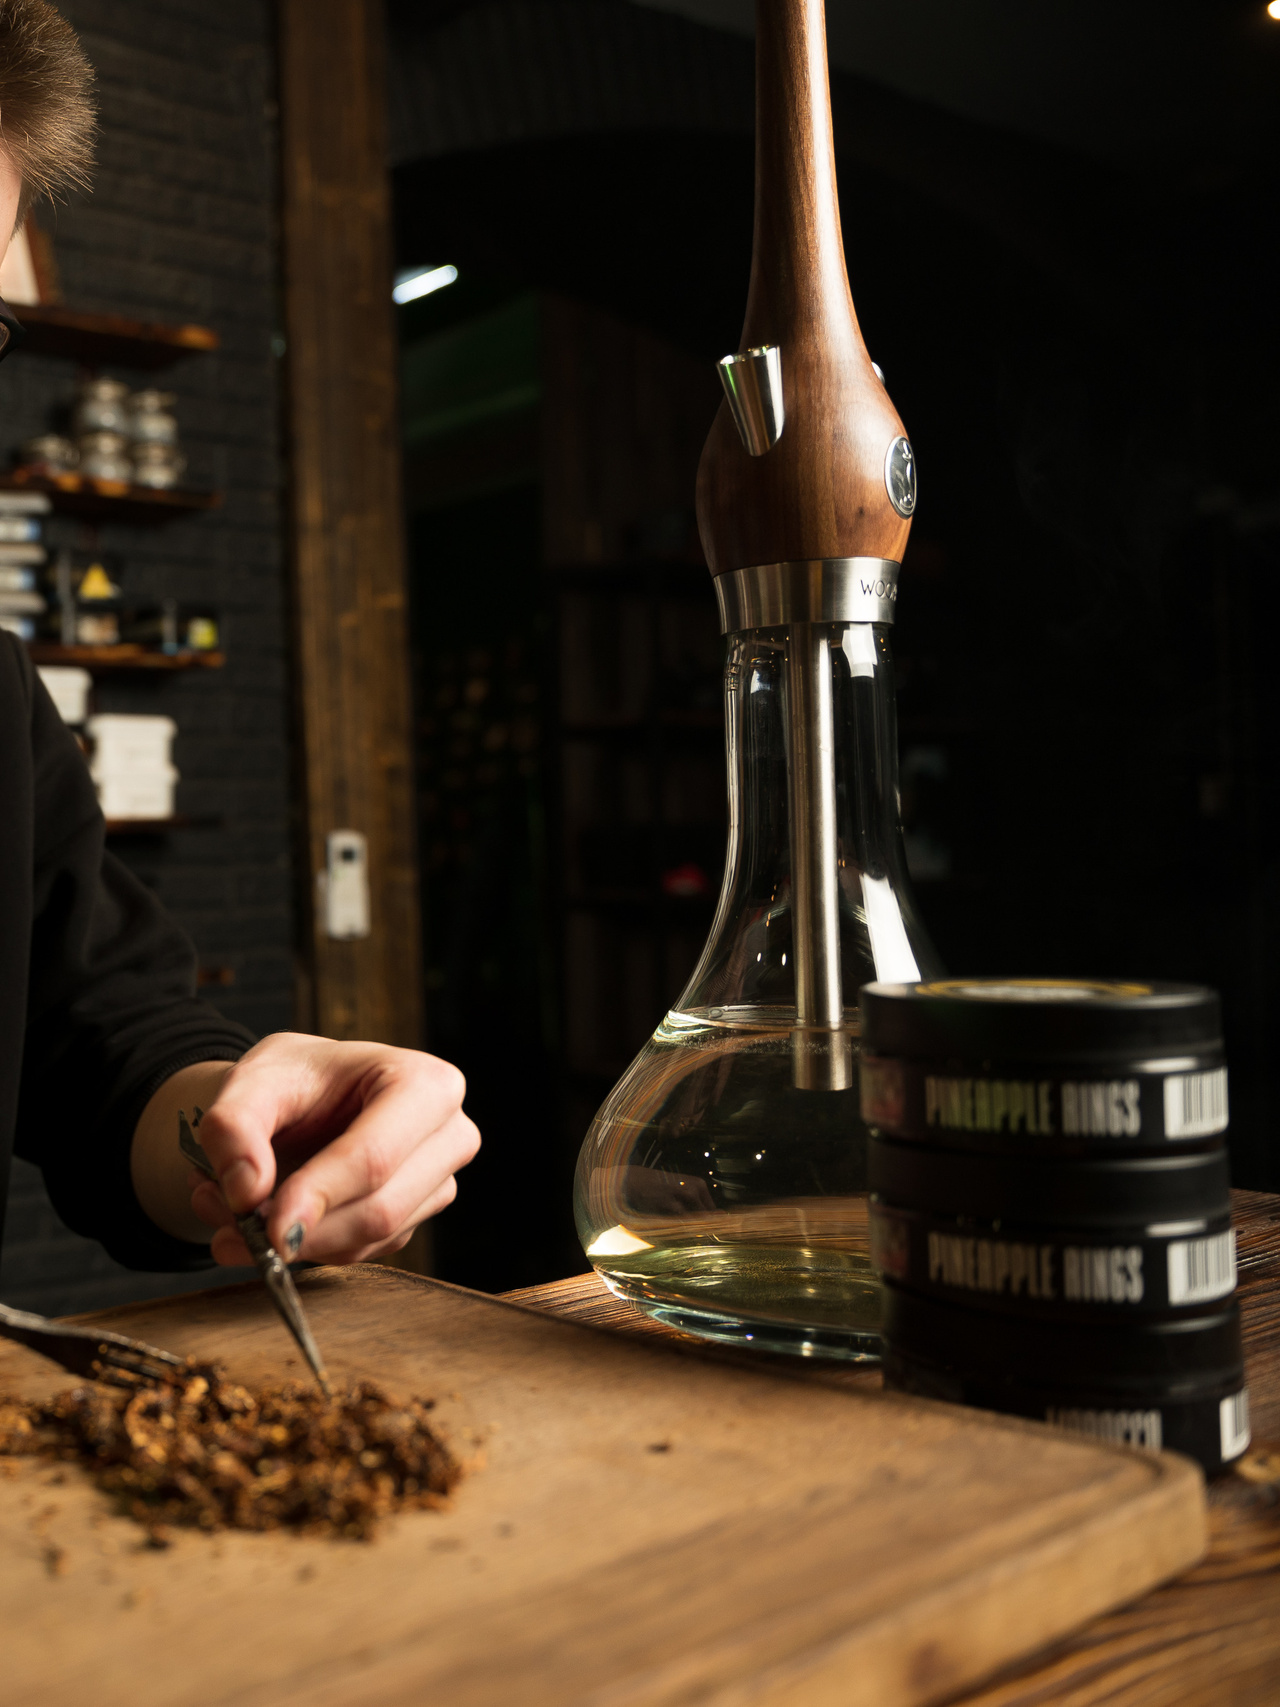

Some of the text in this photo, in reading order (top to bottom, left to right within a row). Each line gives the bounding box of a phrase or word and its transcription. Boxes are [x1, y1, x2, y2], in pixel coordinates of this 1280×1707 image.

[925, 1076, 1142, 1138] PINEAPPLE RINGS
[928, 1230, 1145, 1305] PINEAPPLE RINGS
